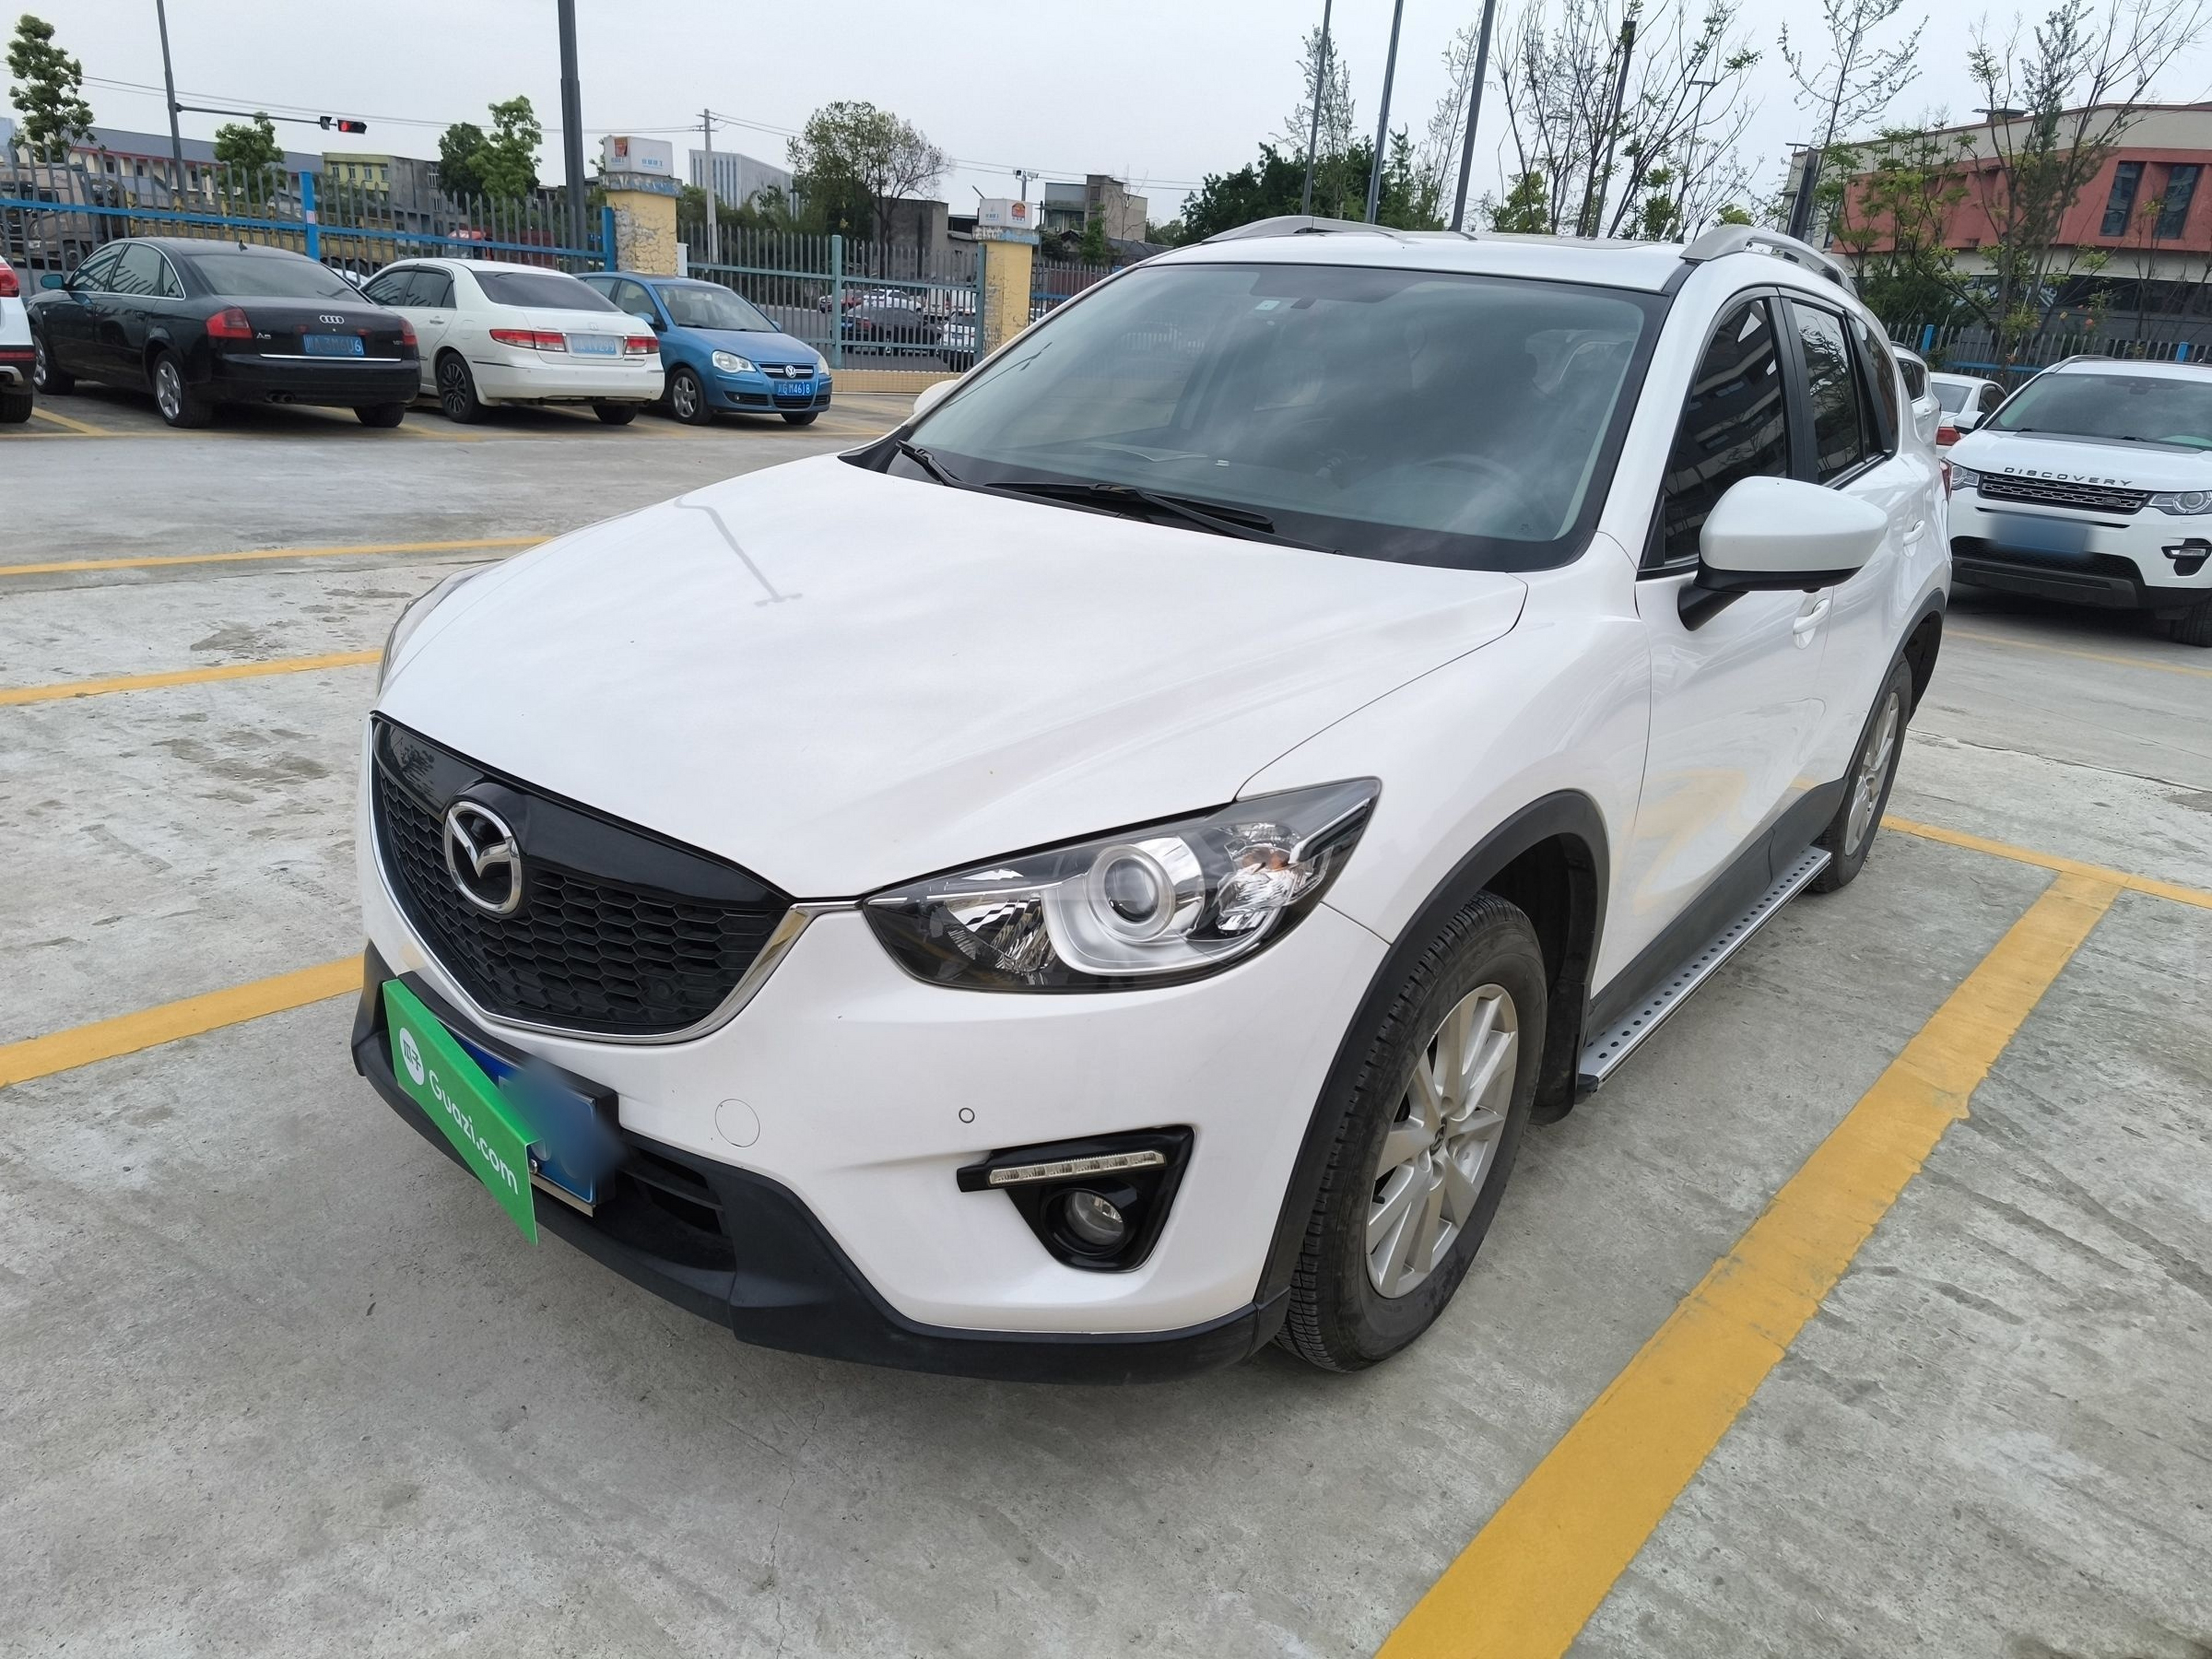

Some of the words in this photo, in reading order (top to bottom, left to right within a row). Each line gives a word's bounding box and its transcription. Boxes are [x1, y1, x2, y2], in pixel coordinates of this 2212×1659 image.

[2004, 467, 2133, 486] DISCOVERY
[403, 1039, 422, 1071] 瓜子
[429, 1070, 518, 1195] Guazi.com
